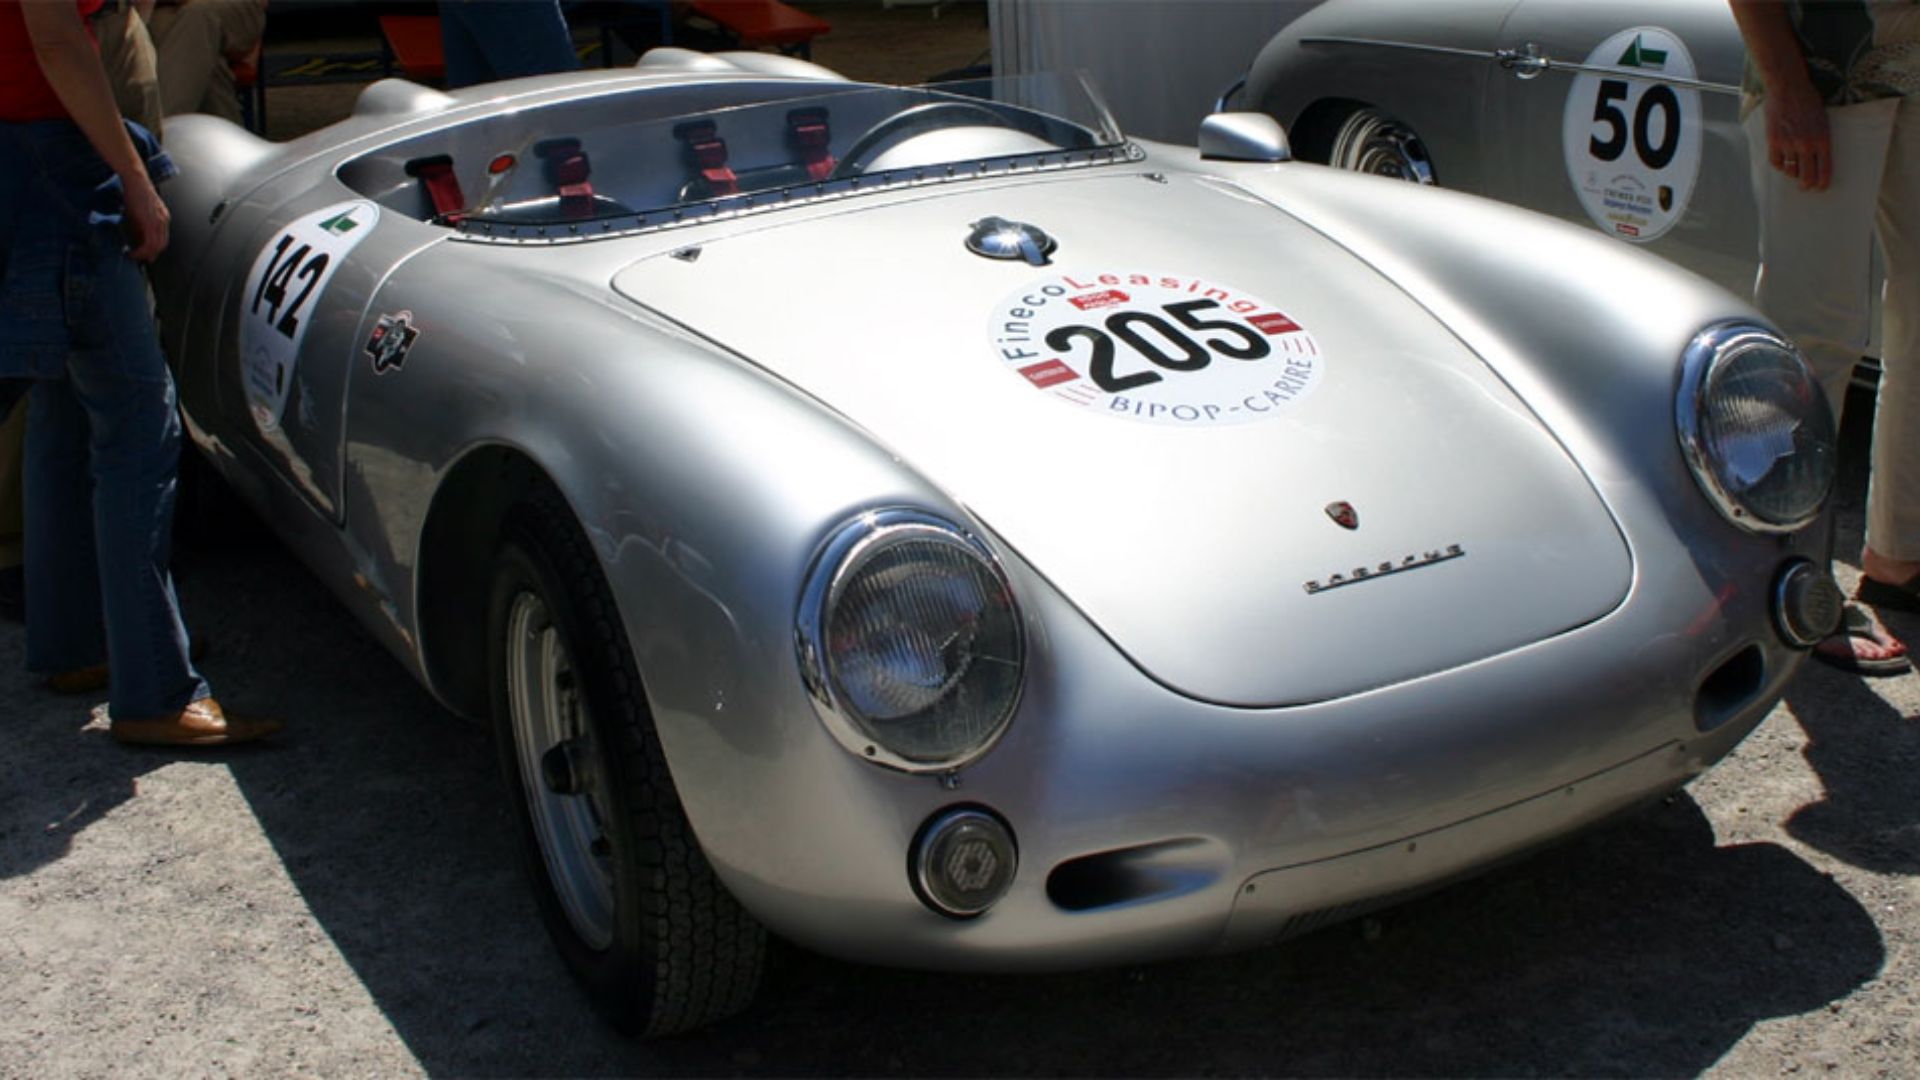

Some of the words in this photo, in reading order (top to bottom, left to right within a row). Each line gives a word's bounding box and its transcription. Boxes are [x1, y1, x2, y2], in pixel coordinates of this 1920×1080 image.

[1589, 79, 1681, 170] 50
[251, 233, 330, 340] 142
[1044, 297, 1272, 394] 205
